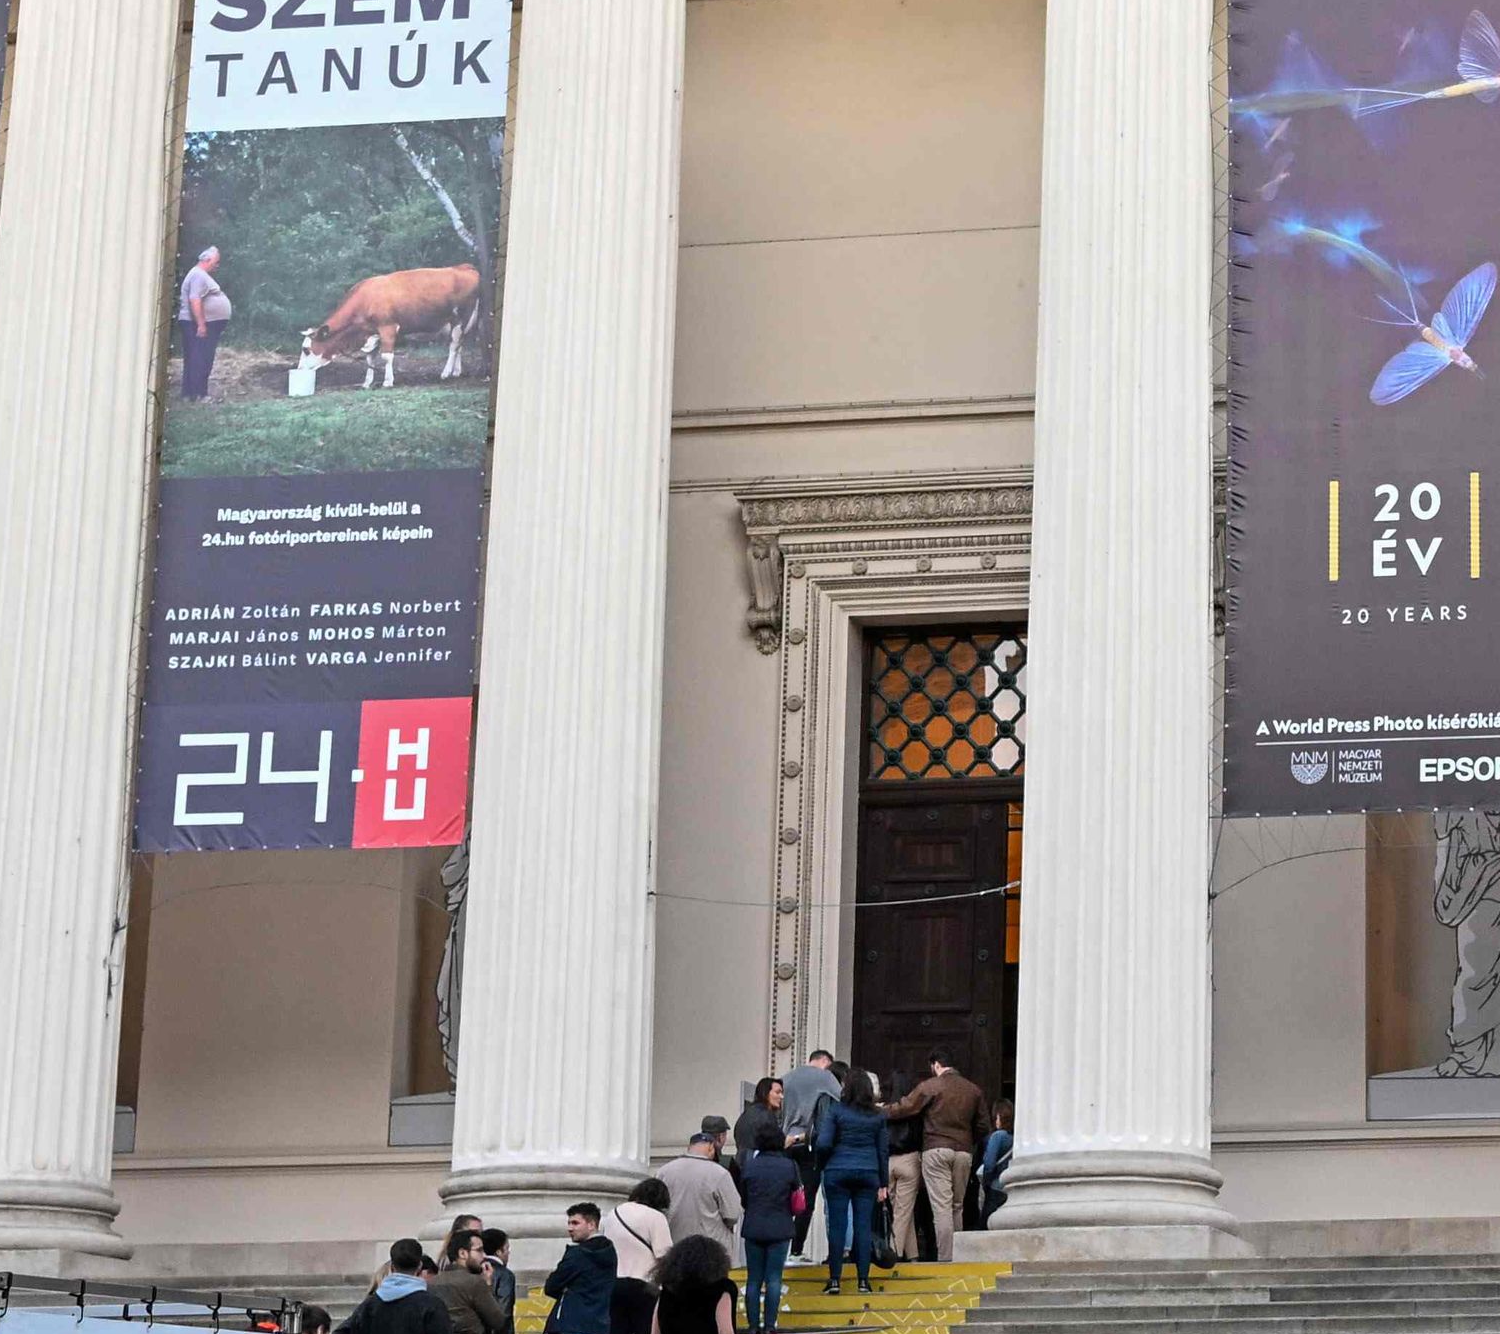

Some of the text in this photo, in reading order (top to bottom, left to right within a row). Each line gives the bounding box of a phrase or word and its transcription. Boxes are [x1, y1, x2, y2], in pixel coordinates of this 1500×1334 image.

[205, 29, 493, 98] TANÚK
[217, 501, 422, 525] Magyarország kívül-belül a
[1372, 481, 1442, 523] 20
[202, 525, 434, 547] 24.hu fotóriportereinek képein
[1372, 527, 1444, 578] ÉV
[165, 599, 462, 622] ADRIÁN Zoltán FARKAS Norbert
[1342, 604, 1469, 625] 20 YEARS
[169, 623, 447, 646] MARJAI János MOHOS Márton
[168, 647, 453, 670] SZAJKI Bálint VARGA Jennifer
[1256, 722, 1270, 736] A
[1272, 717, 1323, 735] World
[1327, 715, 1370, 733] Press
[1373, 714, 1425, 732] Photo
[1291, 750, 1328, 766] MNM
[1338, 748, 1383, 760] MAGYAR
[1338, 760, 1383, 773] NEMZETI
[1338, 770, 1383, 784] MÚZEUM
